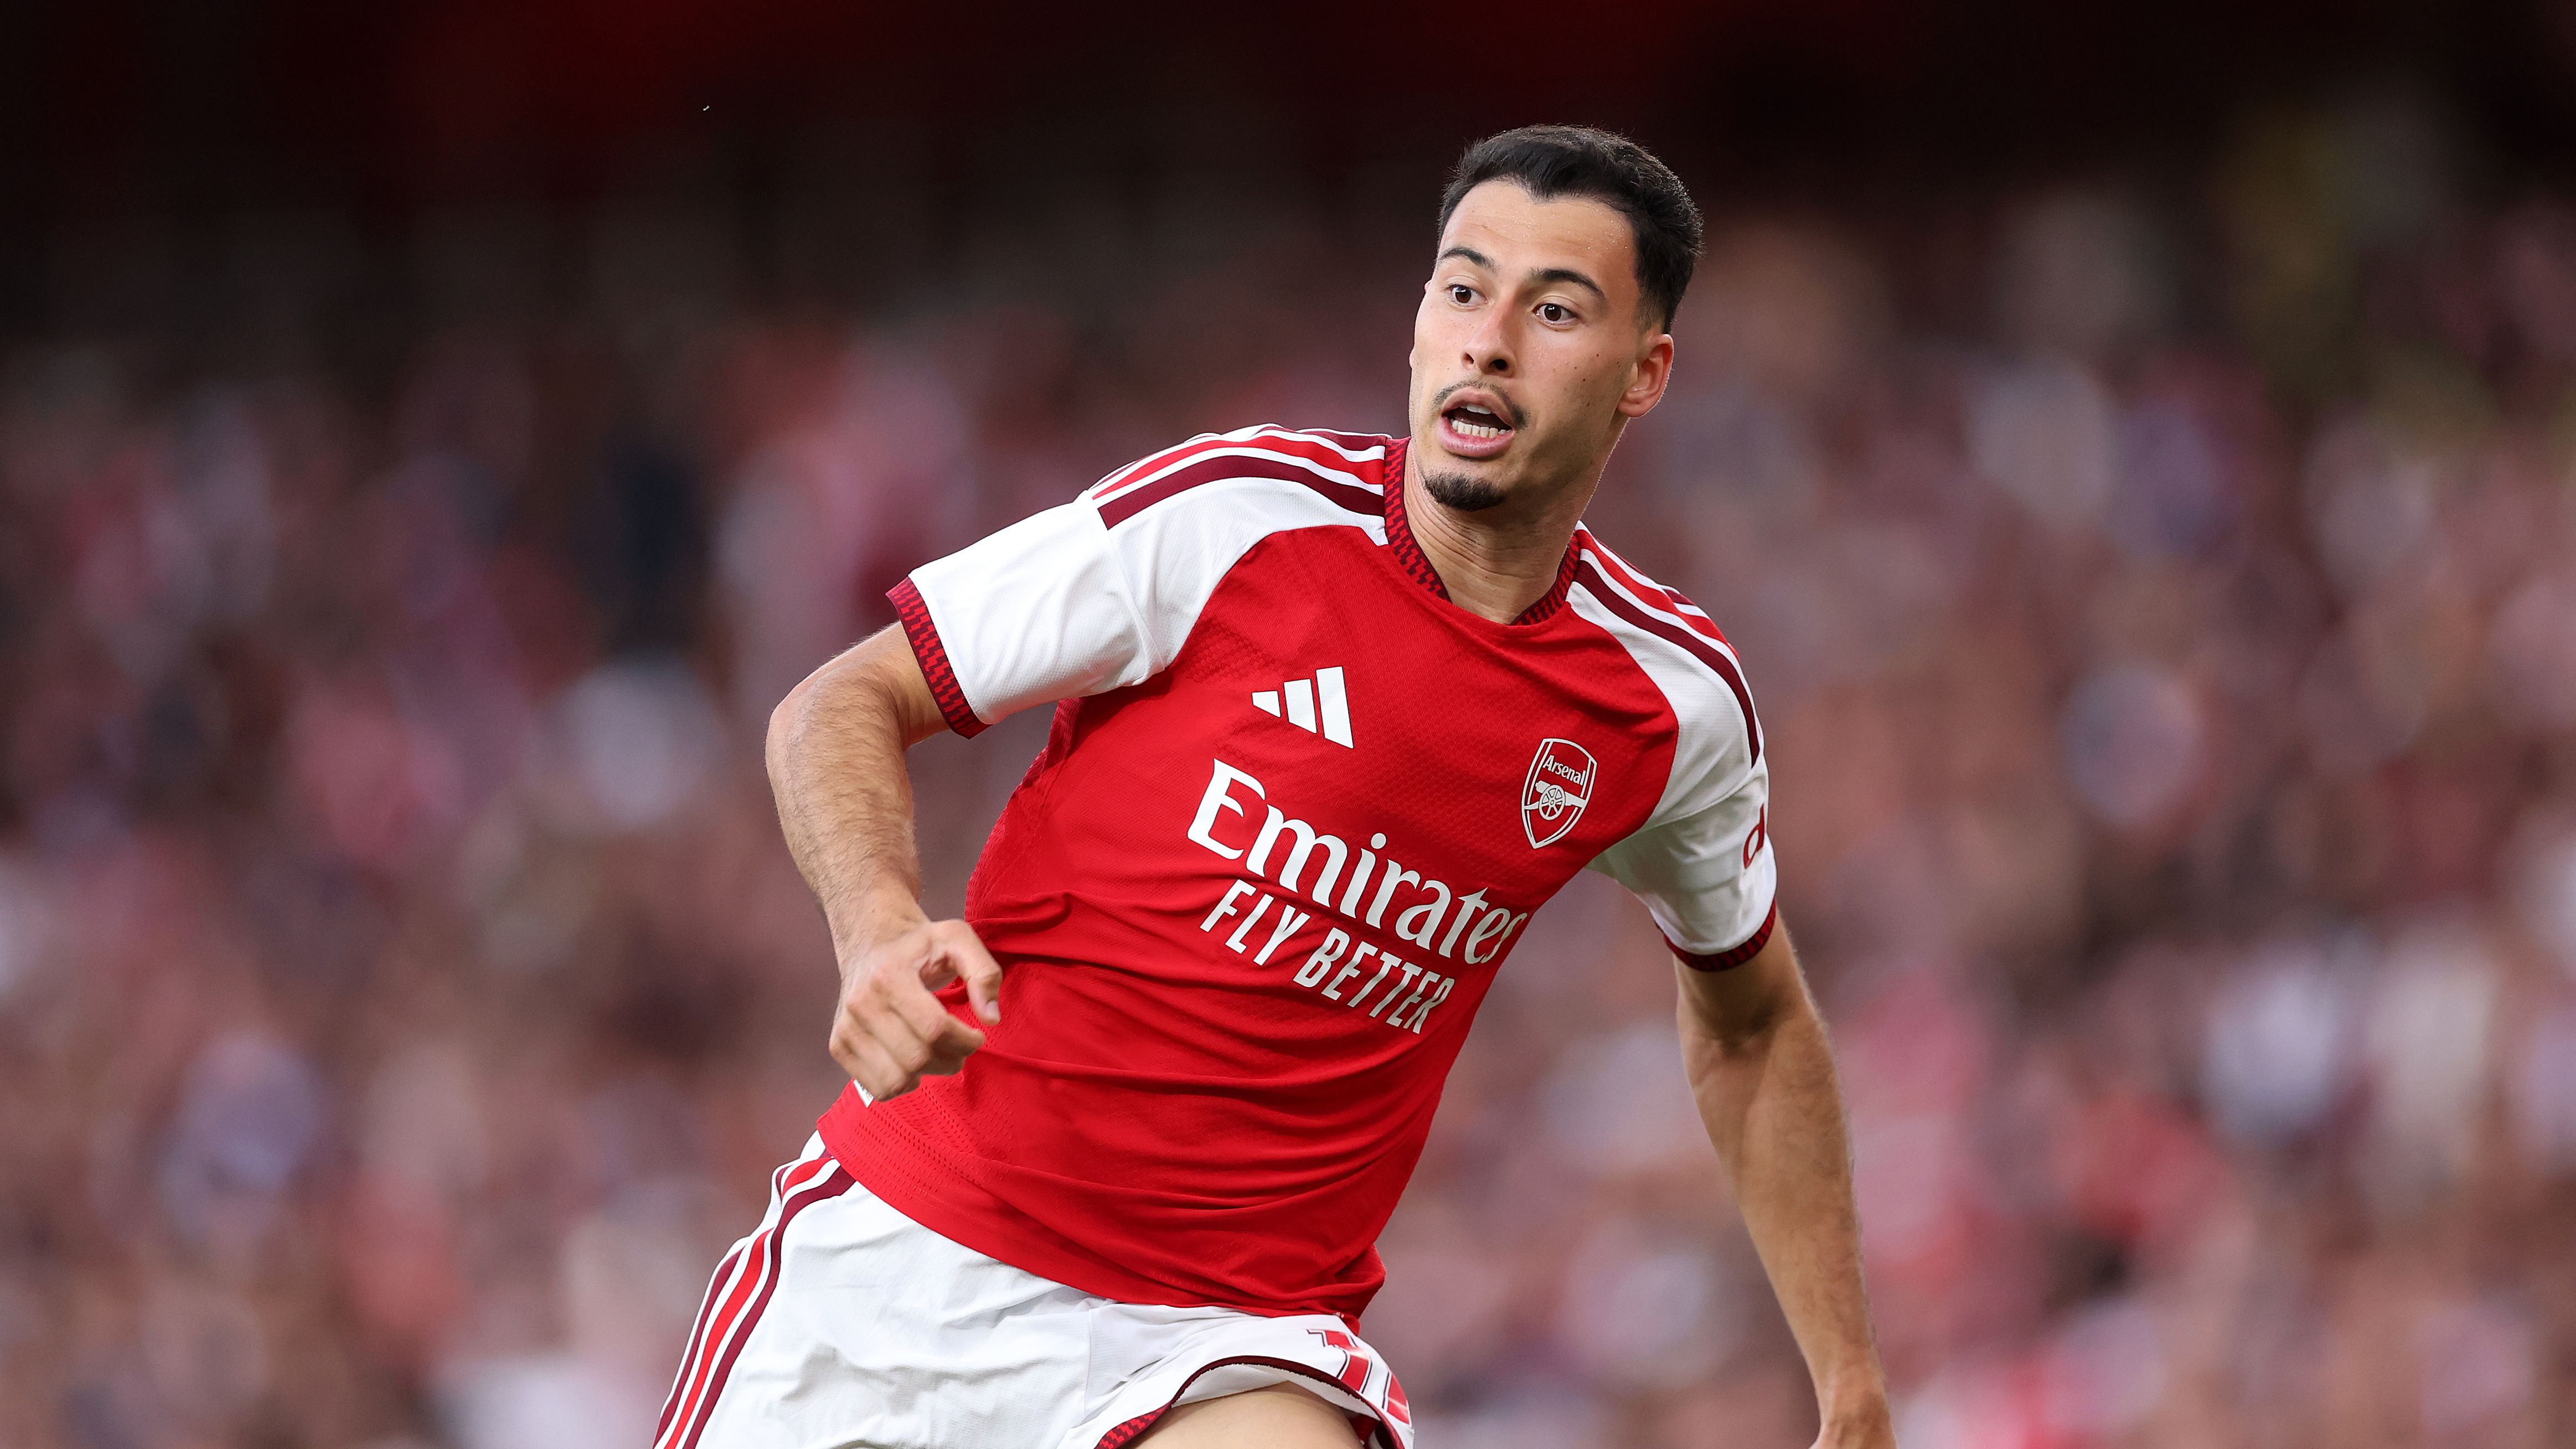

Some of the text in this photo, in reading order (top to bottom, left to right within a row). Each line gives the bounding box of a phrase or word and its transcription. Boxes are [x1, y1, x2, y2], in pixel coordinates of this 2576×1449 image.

[1542, 755, 1586, 786] Arsenal
[1187, 758, 1528, 964] Emirates
[1200, 879, 1455, 1035] FLY BETTER
